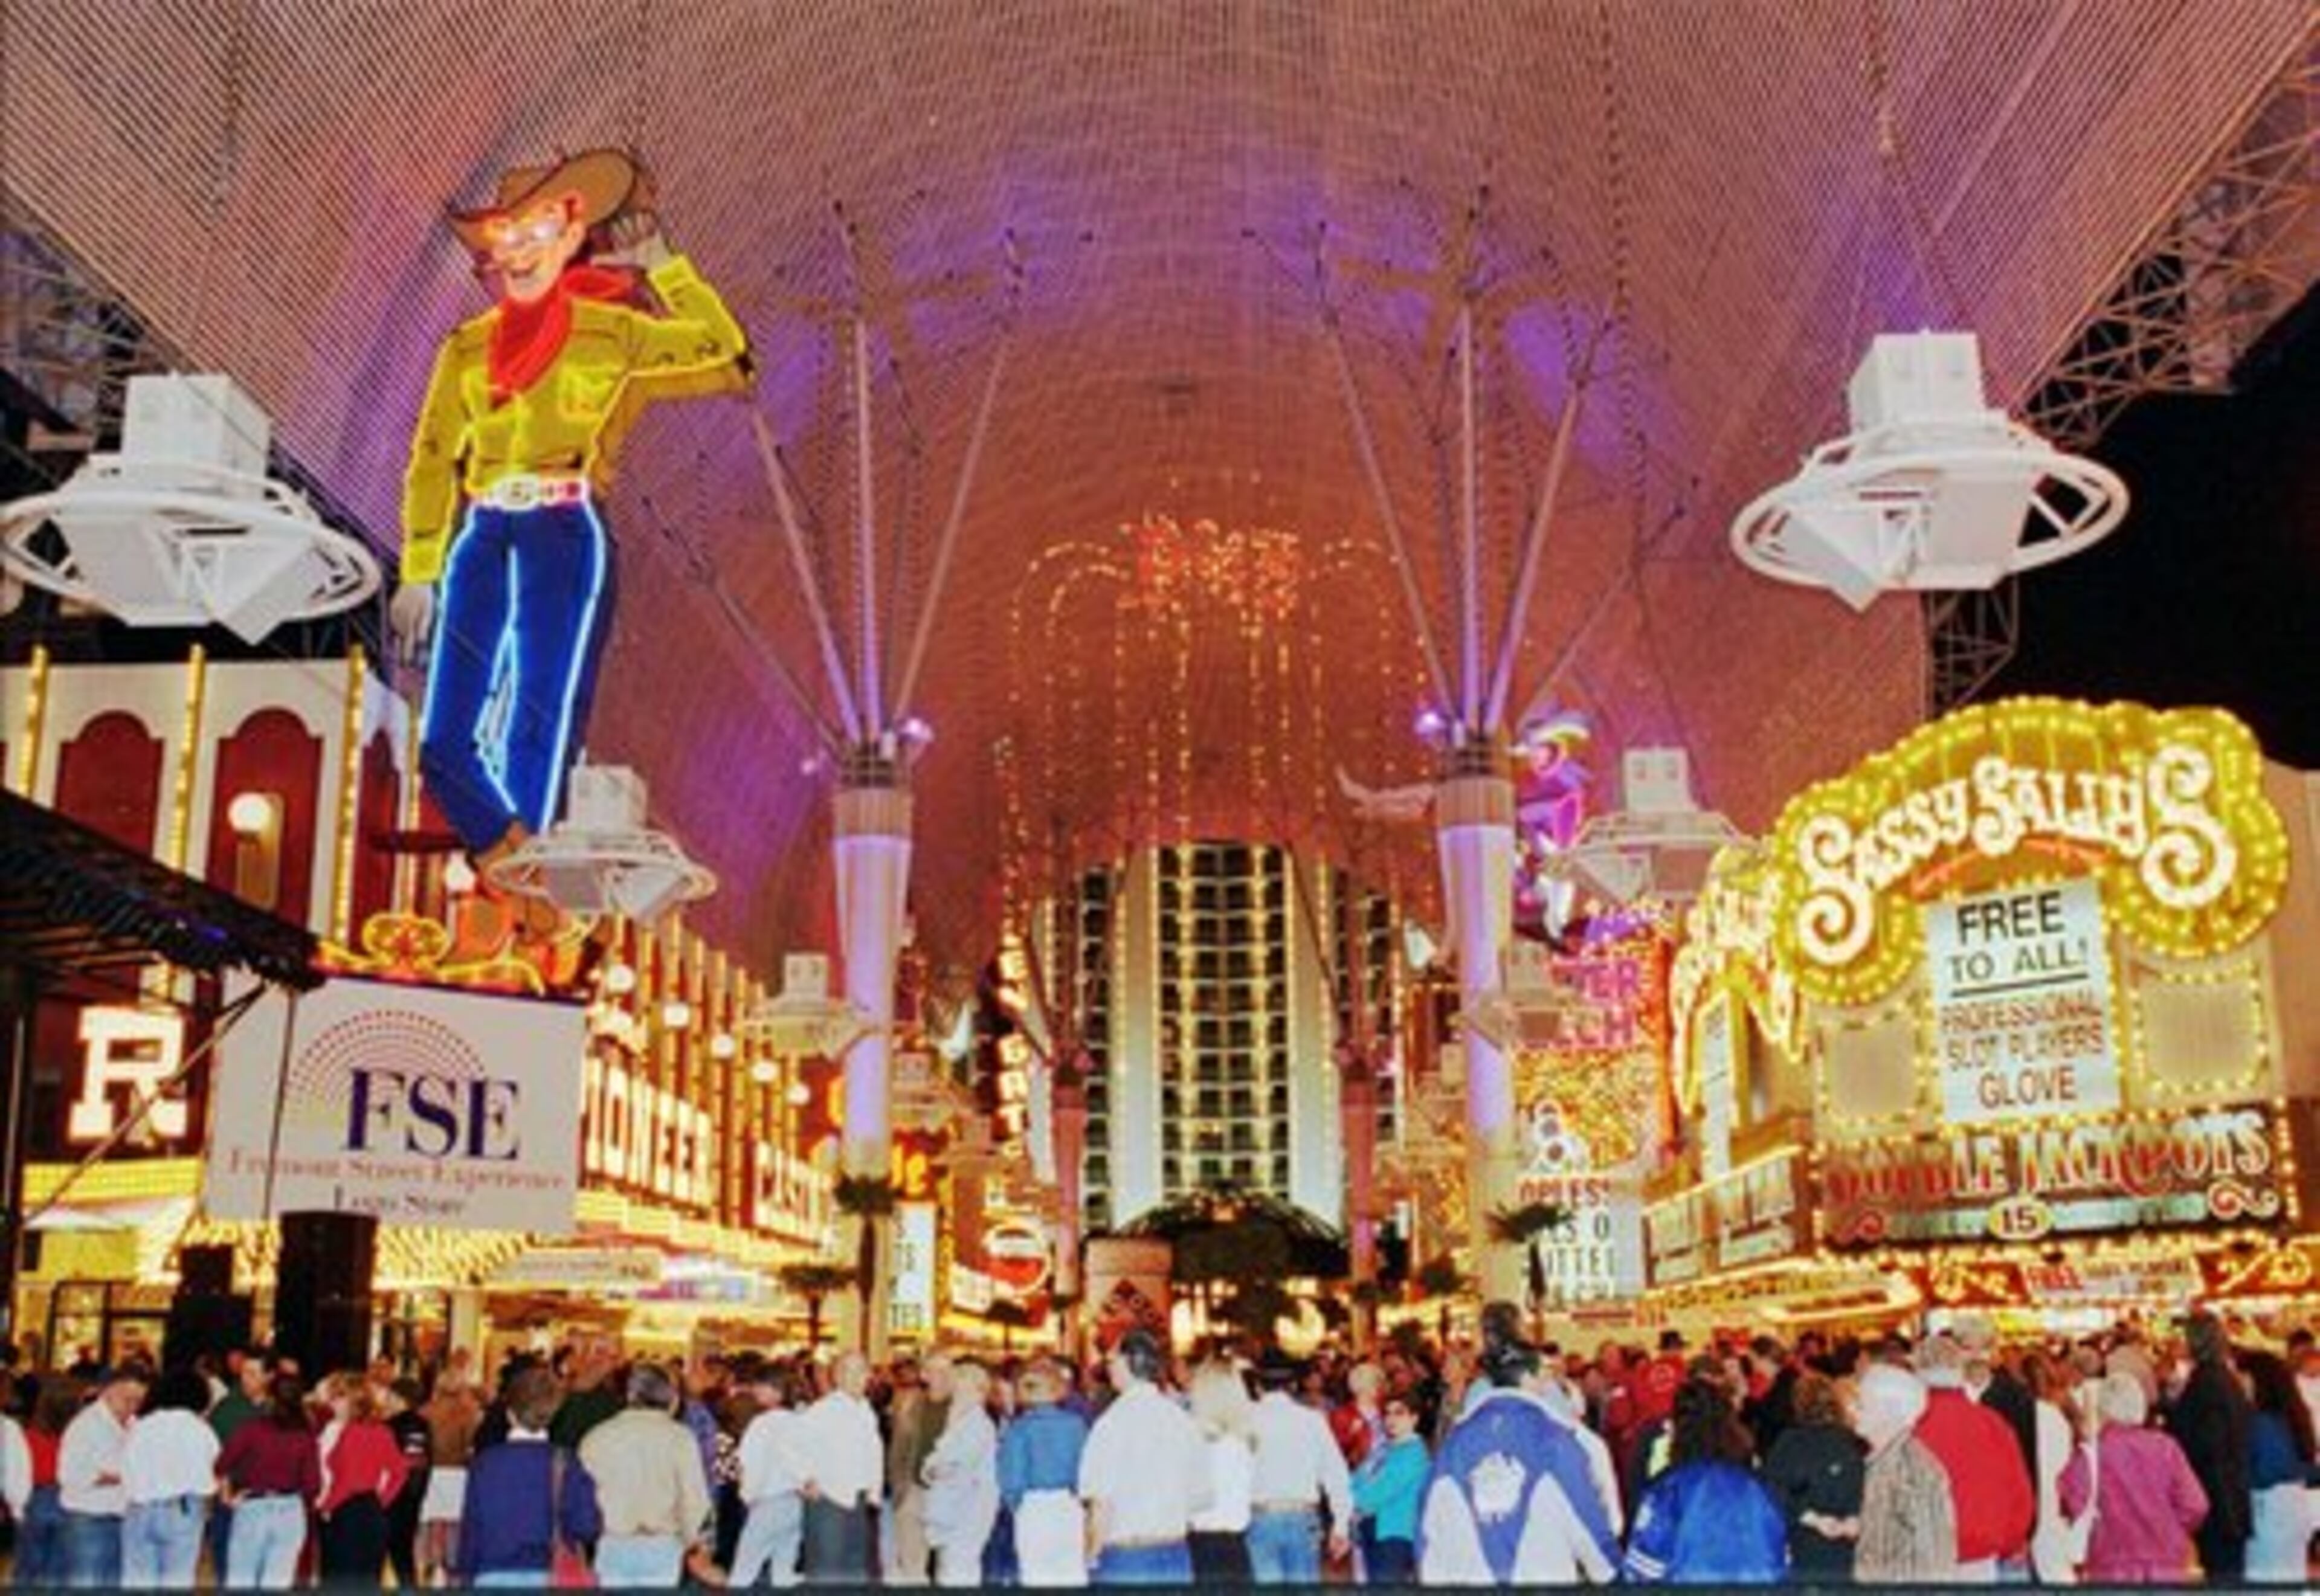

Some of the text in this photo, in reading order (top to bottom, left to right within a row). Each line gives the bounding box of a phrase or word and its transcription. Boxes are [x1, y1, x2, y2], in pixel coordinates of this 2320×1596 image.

[1956, 890, 2064, 945] FREE
[1948, 938, 2089, 983] TO ALL!
[1939, 989, 2102, 1034] PROFESSIONAL
[1947, 1021, 2104, 1072] SLOT PLAYERS
[69, 1005, 186, 1147] R
[1979, 1065, 2078, 1110] GLOVE
[342, 1068, 521, 1161] FSE
[582, 1051, 713, 1208] IONEER
[230, 1148, 565, 1193] Fremont Street Experience
[2018, 1110, 2272, 1197] JACKPOTS
